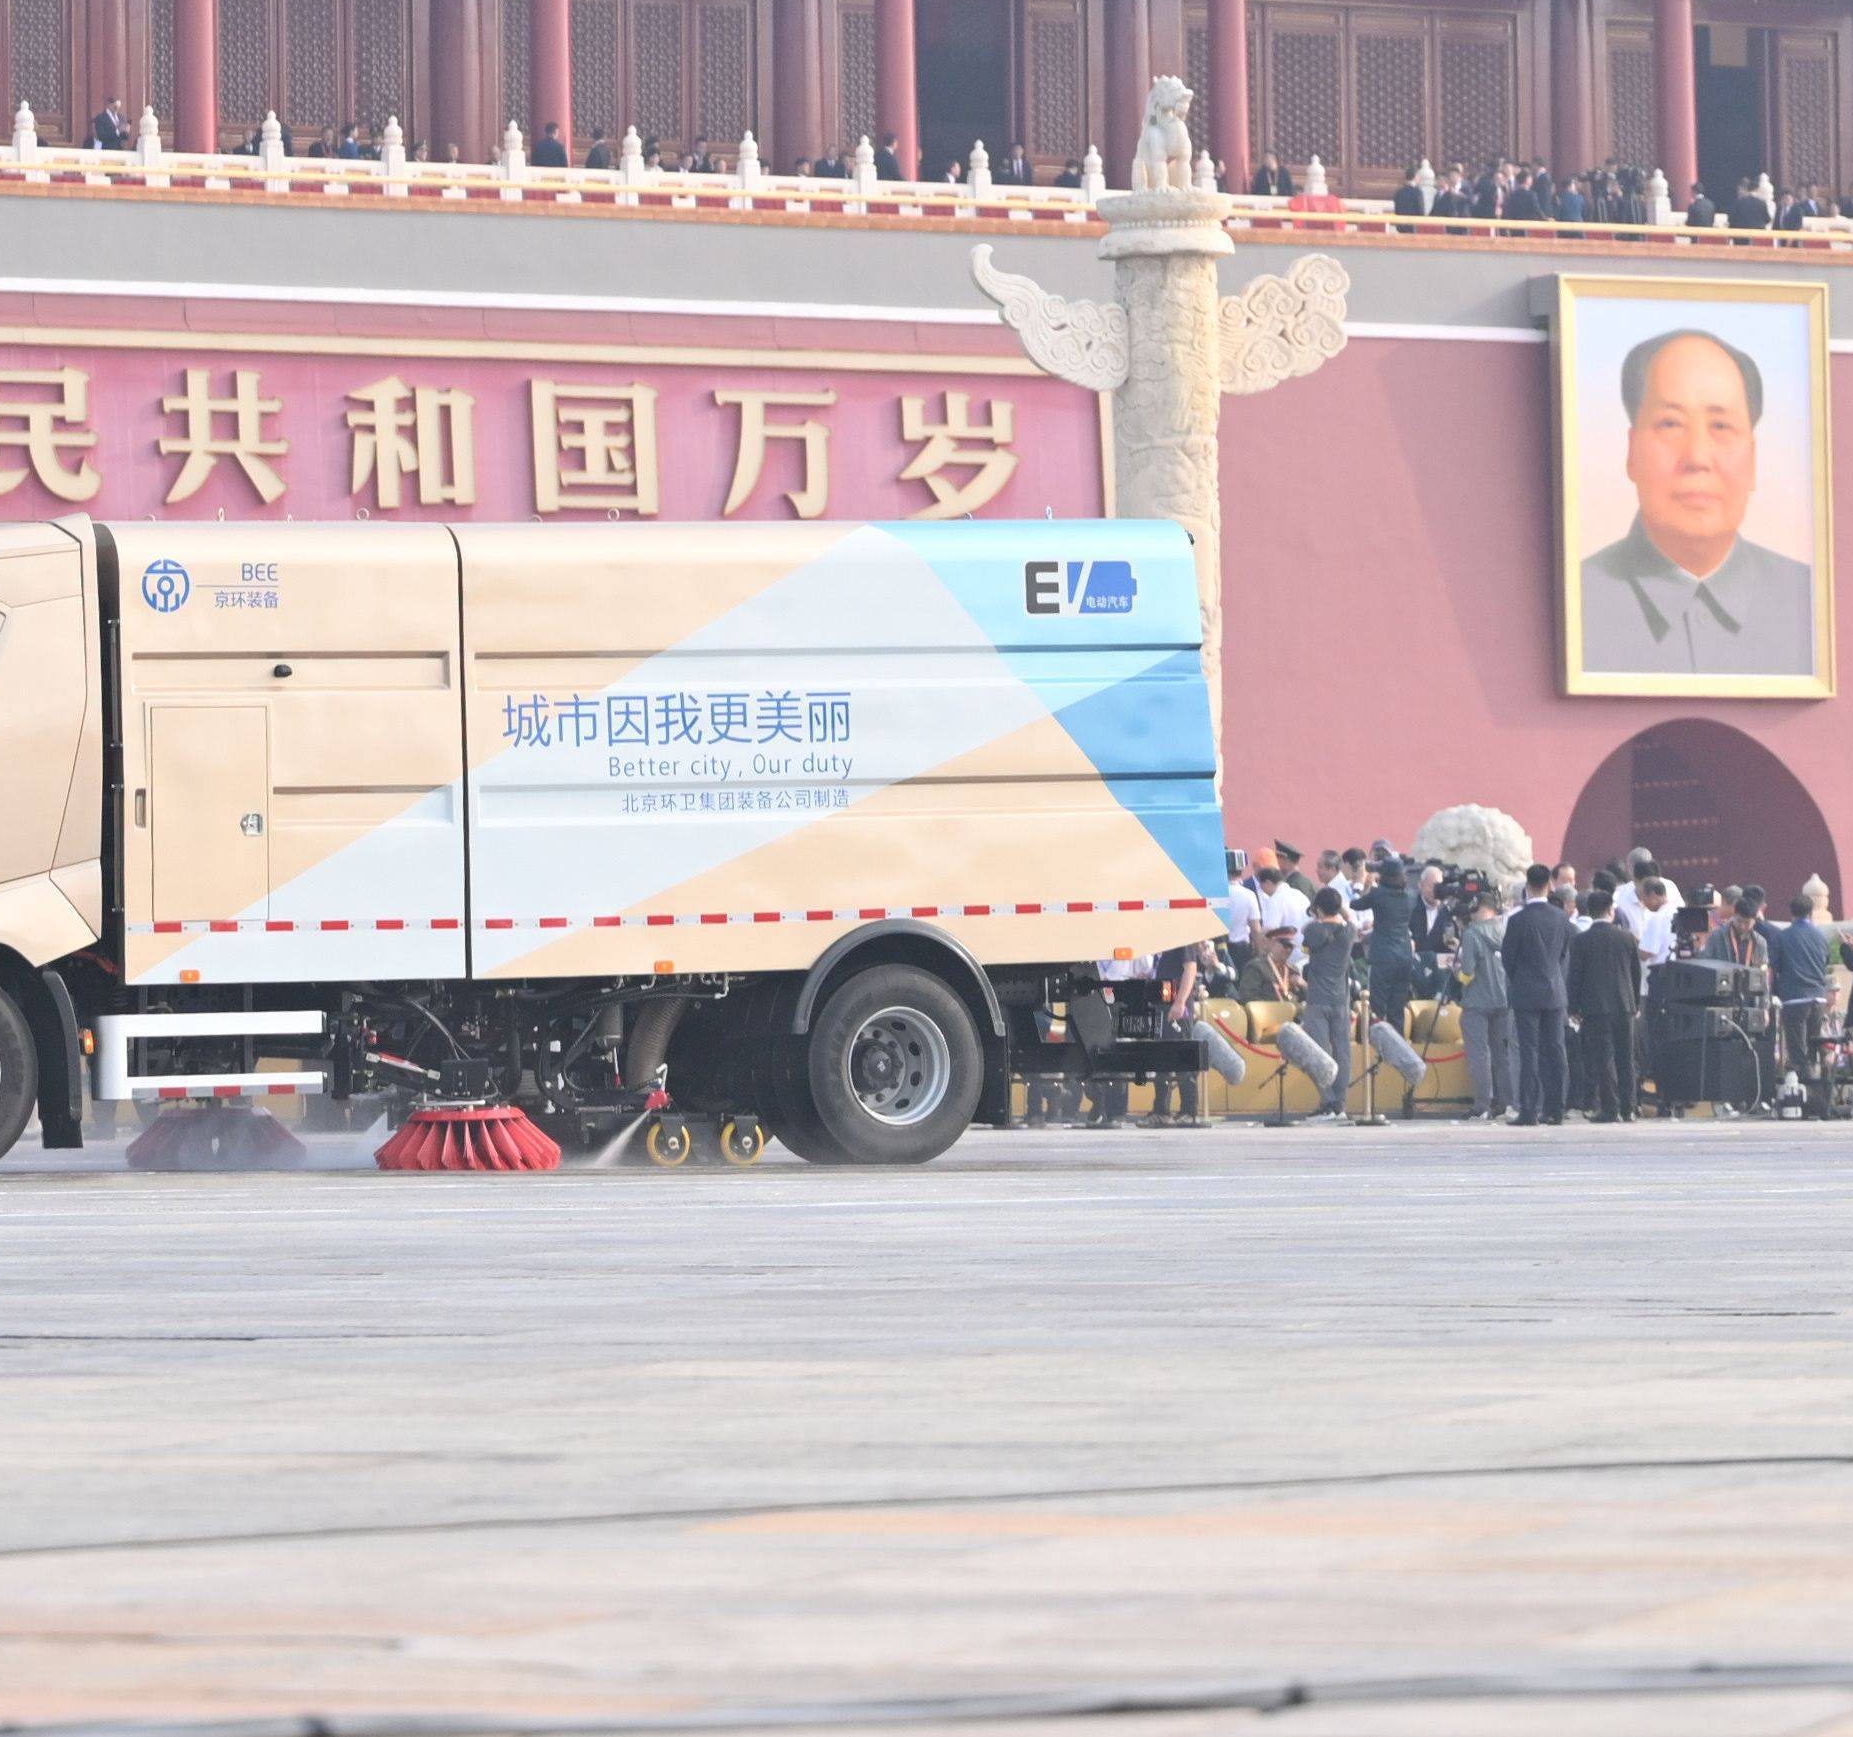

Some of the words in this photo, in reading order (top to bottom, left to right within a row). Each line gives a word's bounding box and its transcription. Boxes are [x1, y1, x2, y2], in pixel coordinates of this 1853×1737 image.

[241, 563, 279, 582] BEE
[214, 590, 279, 609] 京环装备
[1025, 561, 1094, 614] EV
[1086, 595, 1129, 609] 电动汽车
[502, 690, 852, 748] 城市因我更美丽
[609, 756, 680, 777] Better
[752, 753, 792, 775] Our
[802, 752, 853, 780] duty
[621, 788, 850, 813] 北京环卫集团装备公司制造
